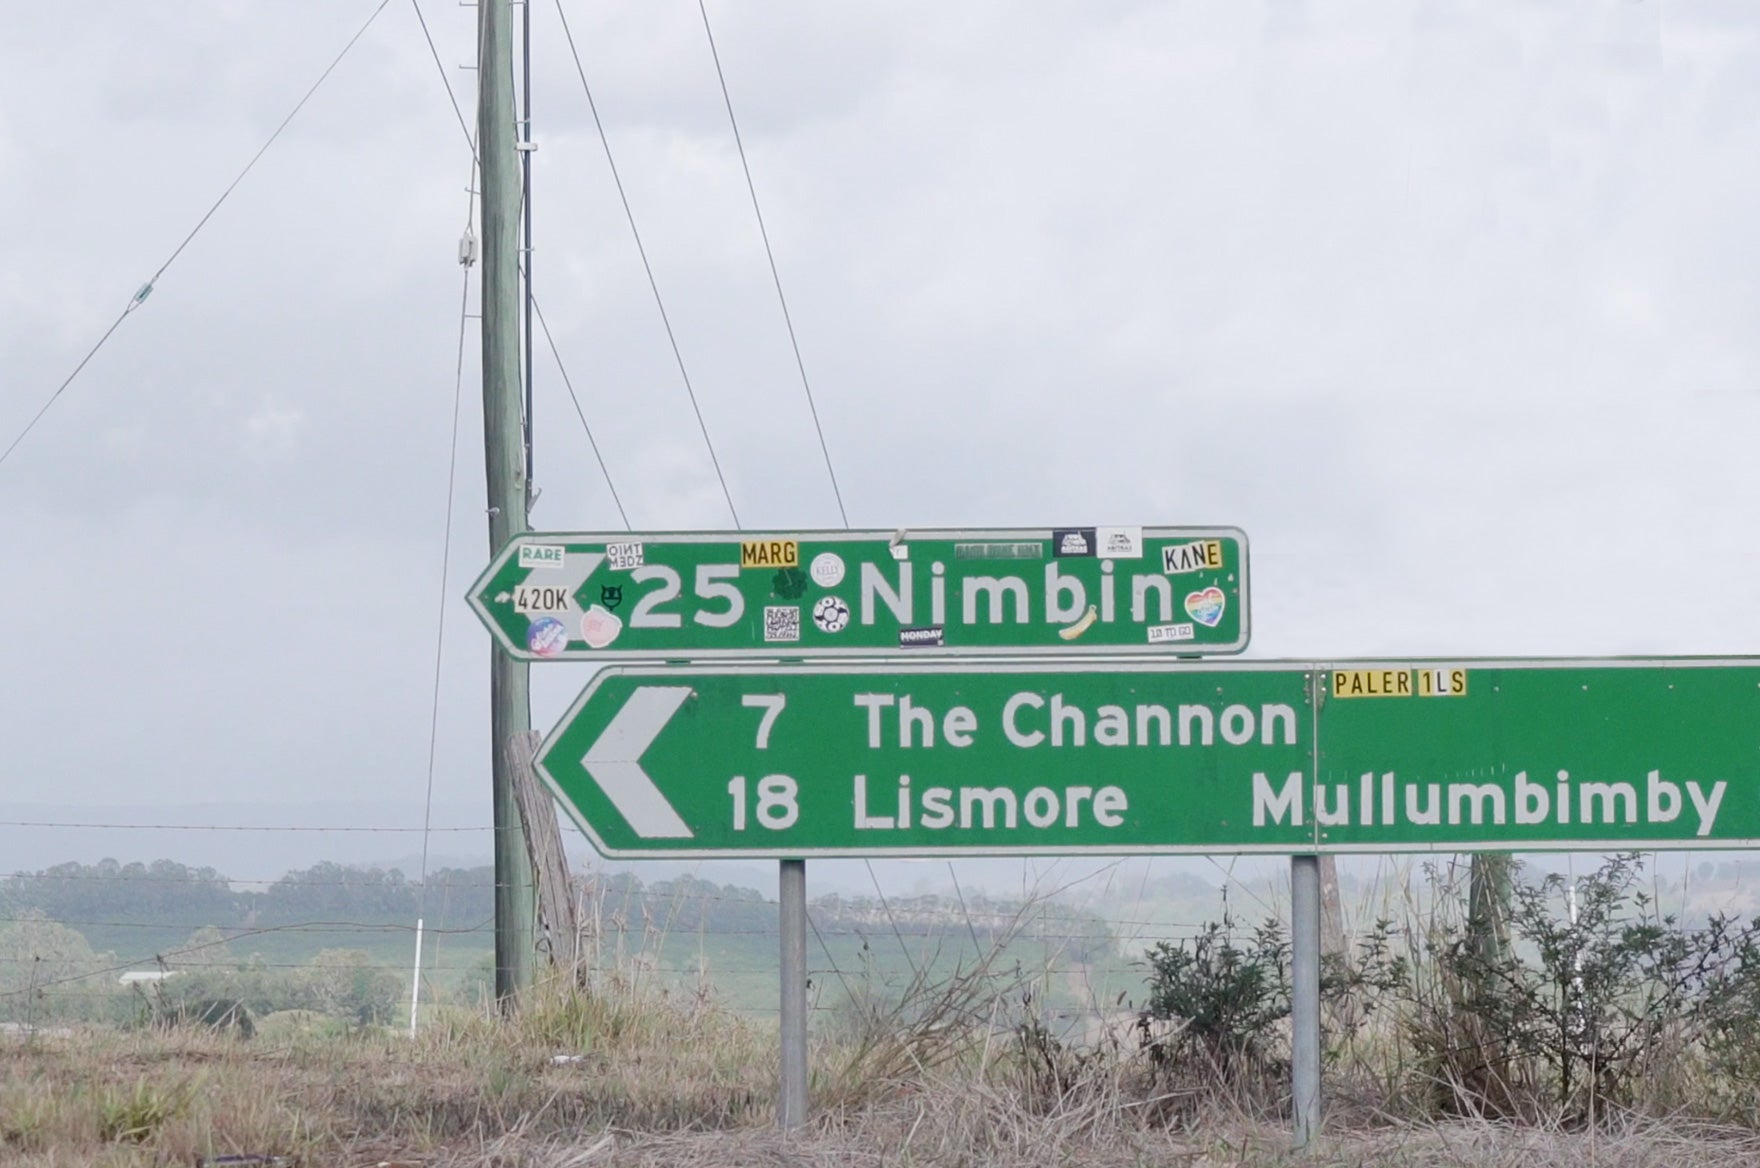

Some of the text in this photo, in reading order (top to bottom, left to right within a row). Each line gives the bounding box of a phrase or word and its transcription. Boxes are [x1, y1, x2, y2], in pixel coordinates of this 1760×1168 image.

[522, 547, 562, 561] RARE
[742, 542, 796, 565] MARG
[1164, 543, 1219, 571] KANE
[517, 588, 569, 611] 420K
[627, 560, 1173, 627] 25 Nimbin
[900, 629, 943, 642] MONDAY
[1335, 672, 1409, 694] PALER
[742, 692, 1297, 749] 7 The Channon
[728, 774, 1128, 830] 18 Lismore
[1252, 769, 1727, 837] Mullumbimby
